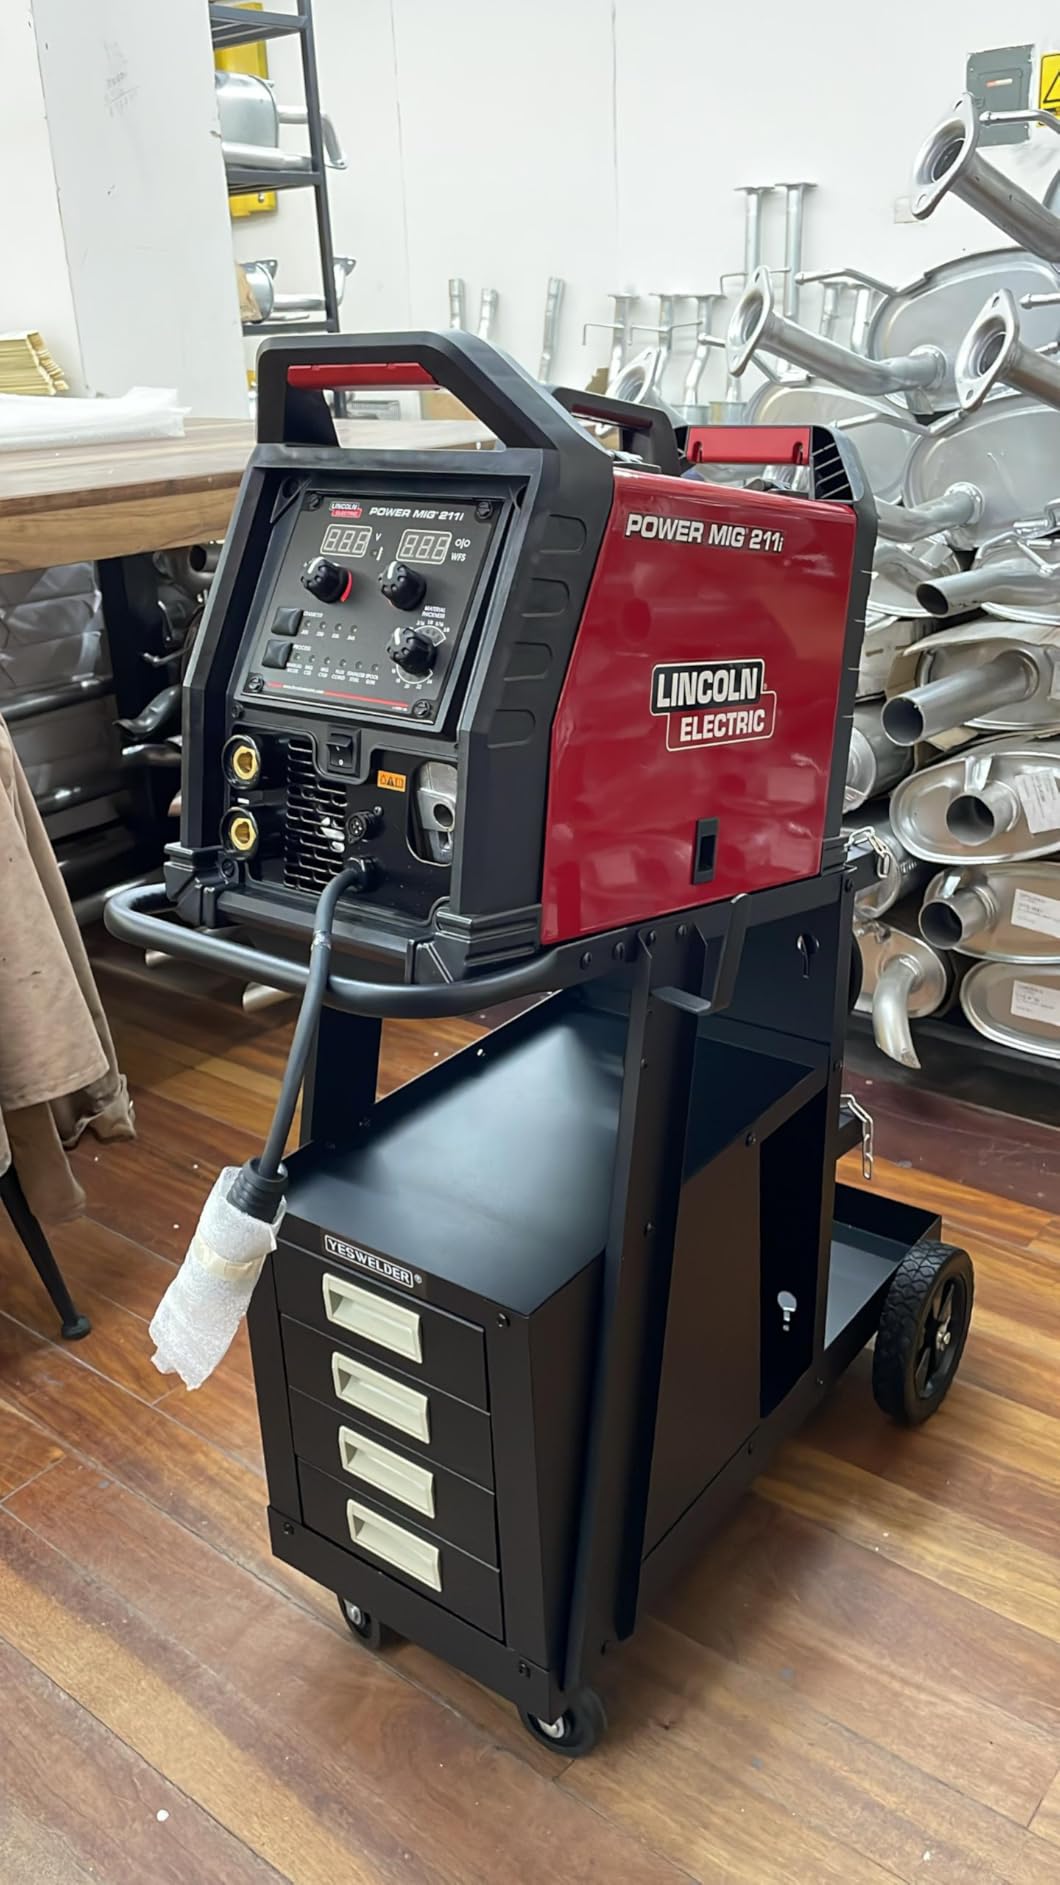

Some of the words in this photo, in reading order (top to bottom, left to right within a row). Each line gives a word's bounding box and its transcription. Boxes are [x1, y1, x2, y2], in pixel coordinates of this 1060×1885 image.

[369, 507, 411, 518] POWER
[625, 513, 704, 544] POWER
[749, 529, 784, 552] 211i
[450, 552, 467, 562] WFS
[657, 667, 758, 708] LINCOLN
[680, 709, 765, 742] ELECTRIC
[328, 1239, 410, 1283] YESWELDER
